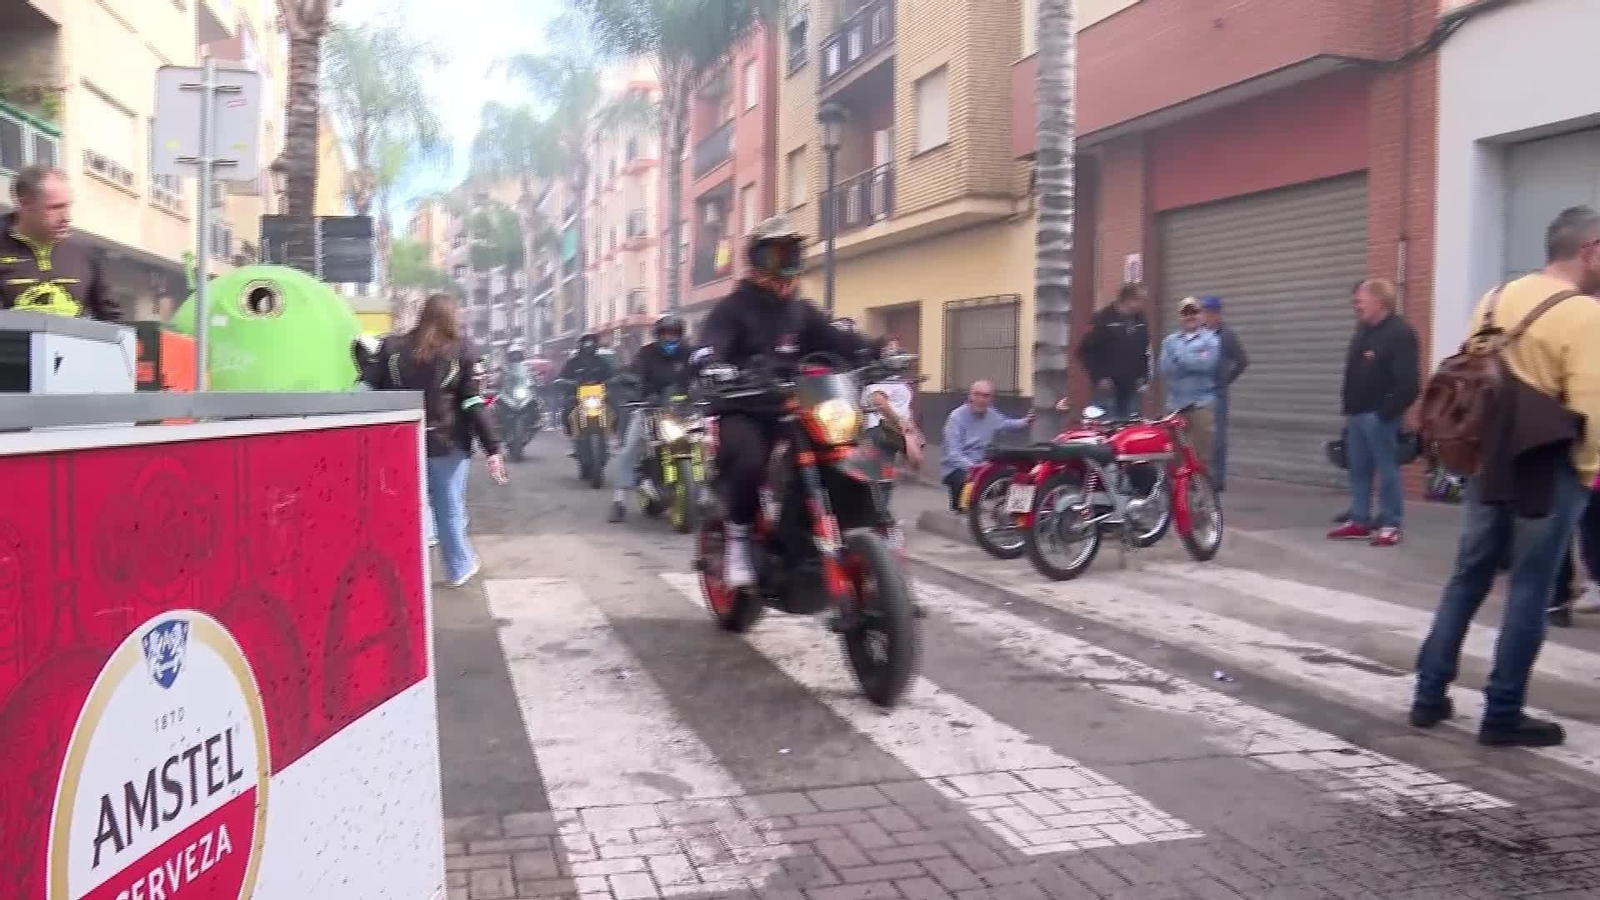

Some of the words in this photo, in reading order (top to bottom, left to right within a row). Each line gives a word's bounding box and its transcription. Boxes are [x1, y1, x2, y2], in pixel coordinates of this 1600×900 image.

[153, 706, 185, 733] 1870
[91, 727, 244, 870] AMSTEL
[115, 823, 233, 900] ERVEZA
